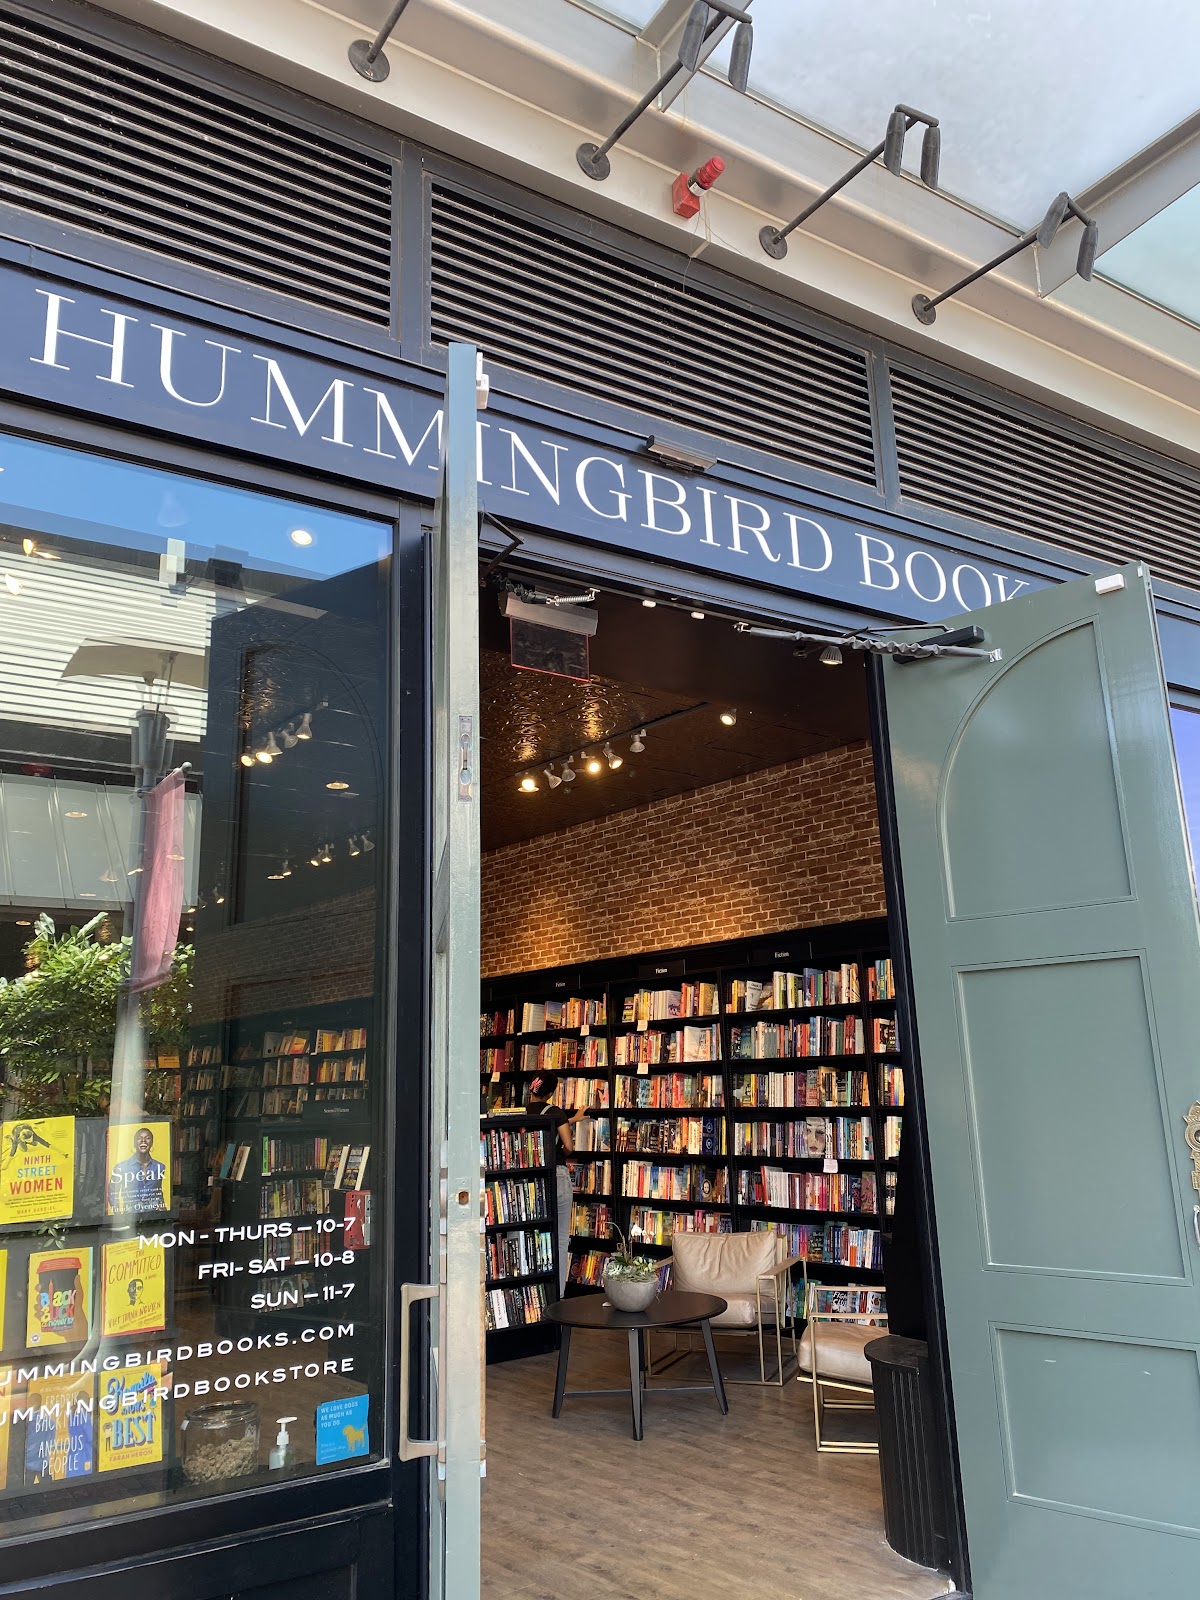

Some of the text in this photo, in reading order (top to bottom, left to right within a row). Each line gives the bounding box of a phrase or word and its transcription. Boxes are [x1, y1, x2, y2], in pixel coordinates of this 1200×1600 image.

[774, 951, 790, 959] Fiction
[23, 1154, 51, 1166] NINTH
[17, 1165, 57, 1179] STREET
[110, 1164, 166, 1188] Speak
[9, 1177, 63, 1195] WOMEN
[138, 1230, 195, 1249] MON
[214, 1222, 292, 1242] THURS
[315, 1217, 356, 1234] 10-7
[108, 1254, 162, 1285] COMMITTED
[248, 1257, 290, 1275] SAT
[313, 1250, 355, 1267] 10-8
[40, 1285, 77, 1307] BLACK
[250, 1290, 298, 1309] SUN
[322, 1283, 355, 1301] 11-7
[139, 1301, 161, 1316] NGUYEN
[45, 1391, 80, 1409] FREDRIK
[344, 1401, 359, 1409] DOGS
[112, 1413, 156, 1451] BEST
[38, 1434, 84, 1459] ANXIOUS
[109, 1449, 153, 1462] FARAH HERON
[41, 1453, 79, 1478] PEOPLE
